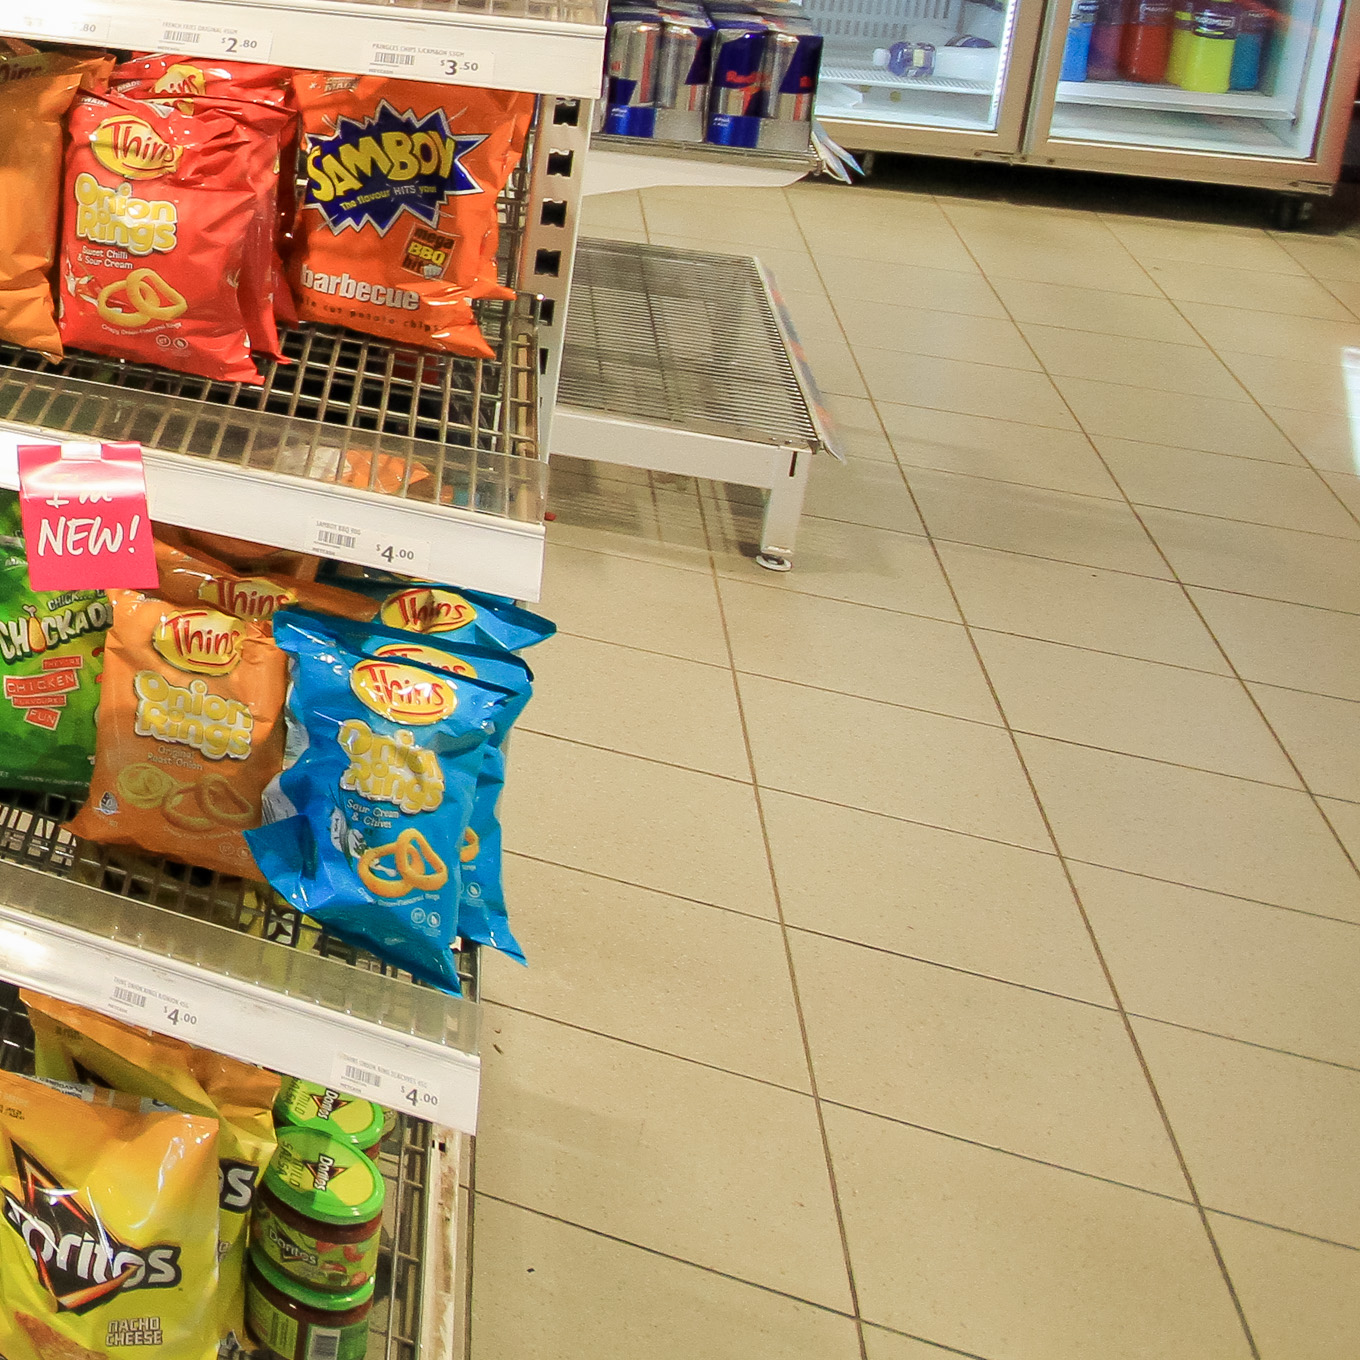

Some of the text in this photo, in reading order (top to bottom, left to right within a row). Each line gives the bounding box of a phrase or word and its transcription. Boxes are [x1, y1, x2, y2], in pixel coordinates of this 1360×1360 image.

[221, 37, 257, 53] $2.80
[440, 59, 479, 75] $3.50
[108, 121, 179, 165] Thins
[306, 130, 456, 202] SAMBOY
[74, 172, 178, 223] Onion
[339, 183, 417, 211] The flavour HITS
[77, 206, 178, 256] Rings
[82, 246, 128, 261] Sweet Chilli
[85, 255, 133, 270] Sour Cream
[407, 244, 445, 267] BBQ
[299, 264, 421, 311] barbecue
[350, 308, 396, 324] potato
[36, 516, 140, 558] NEW!
[376, 544, 414, 563] $4.00
[164, 610, 241, 658] Thins
[6, 674, 75, 693] CHICKEN
[368, 660, 446, 709] Thins
[135, 670, 254, 727] Onion
[30, 709, 56, 725] FUN
[134, 702, 253, 760] Rings
[339, 755, 445, 814] Rings
[346, 799, 400, 820] Sour Cream
[164, 1006, 197, 1025] $4.00
[401, 1085, 438, 1106] $4.00
[106, 1315, 161, 1333] NACHO
[106, 1329, 164, 1346] CHEESE
